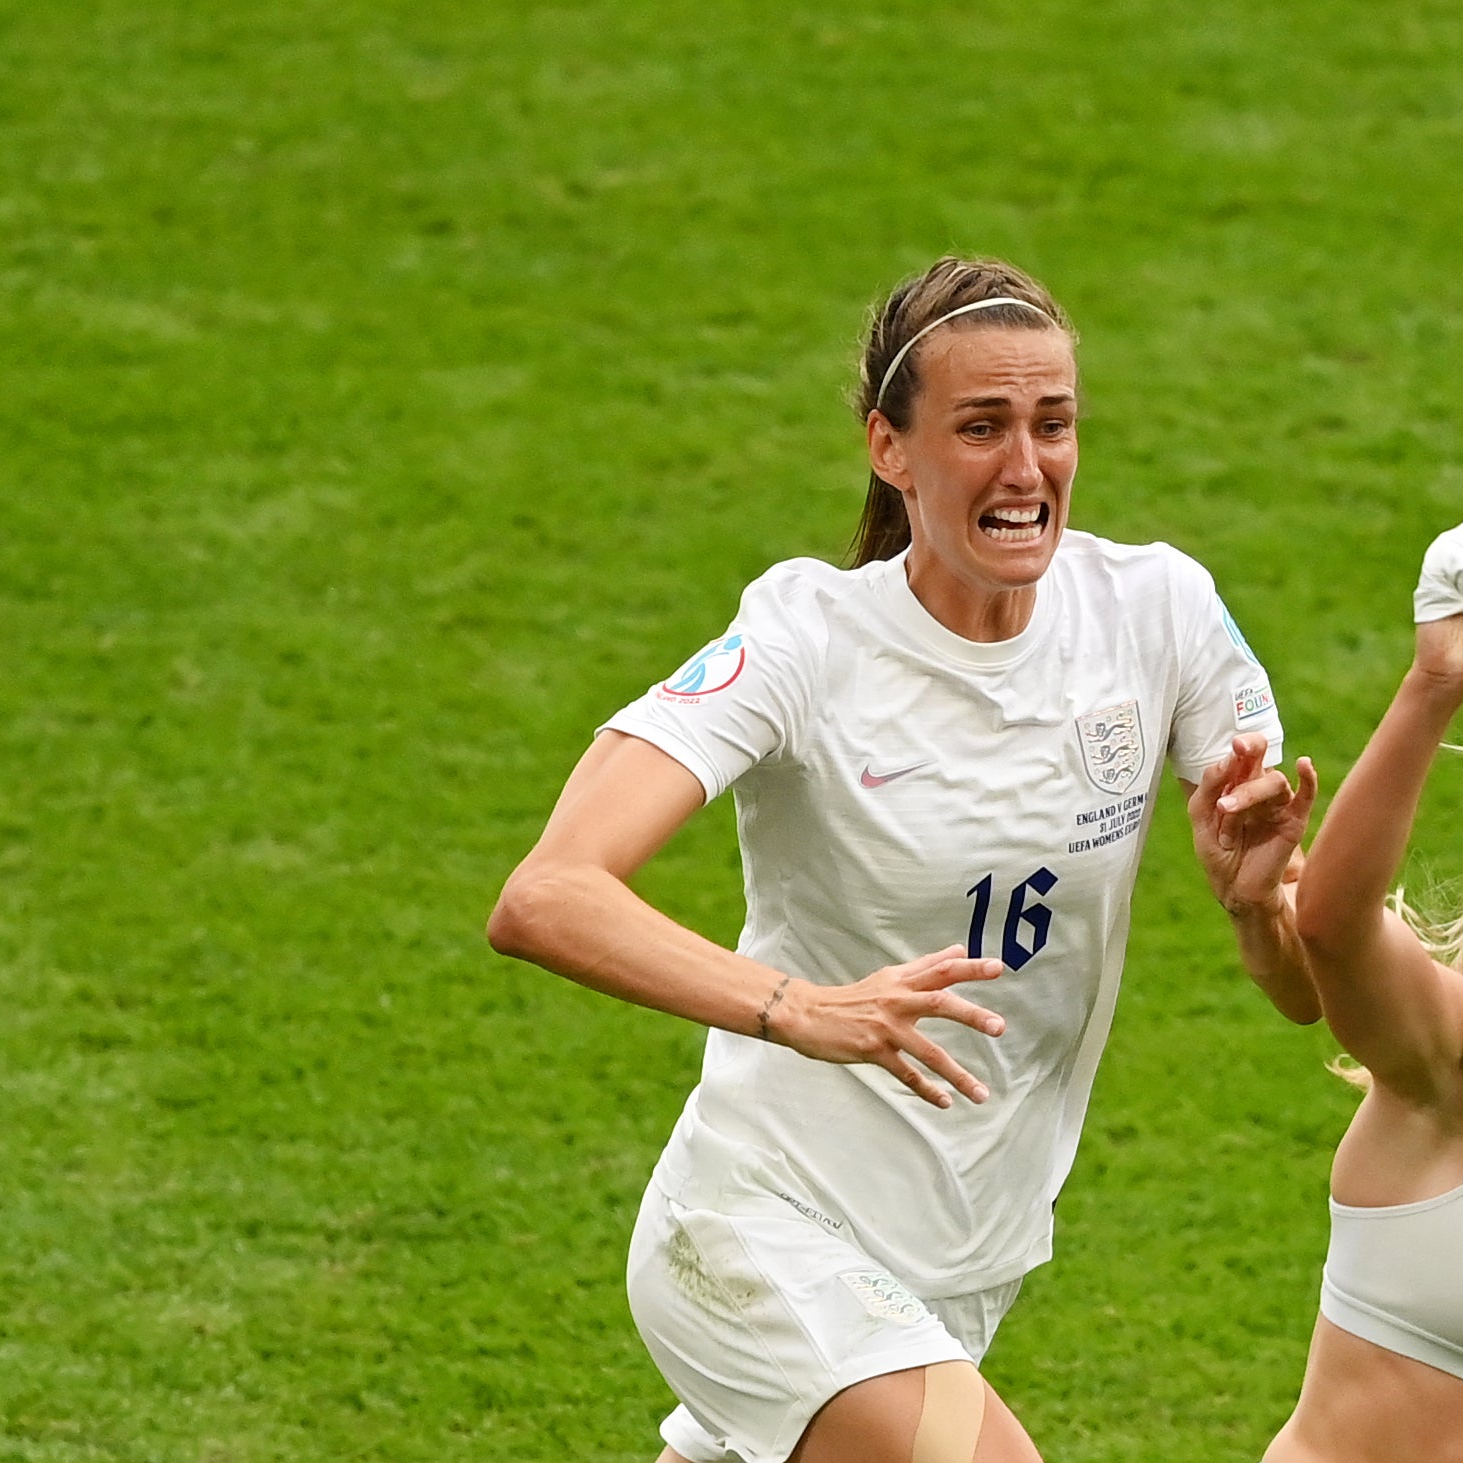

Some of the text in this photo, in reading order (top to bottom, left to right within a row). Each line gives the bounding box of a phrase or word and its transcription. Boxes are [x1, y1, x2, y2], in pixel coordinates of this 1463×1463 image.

[1076, 806, 1116, 825] ENGLAND
[1117, 802, 1123, 814] V
[1108, 813, 1126, 831] JULY
[1068, 839, 1091, 854] UEFA
[1092, 828, 1124, 848] WOMENS
[966, 866, 1059, 972] 16
